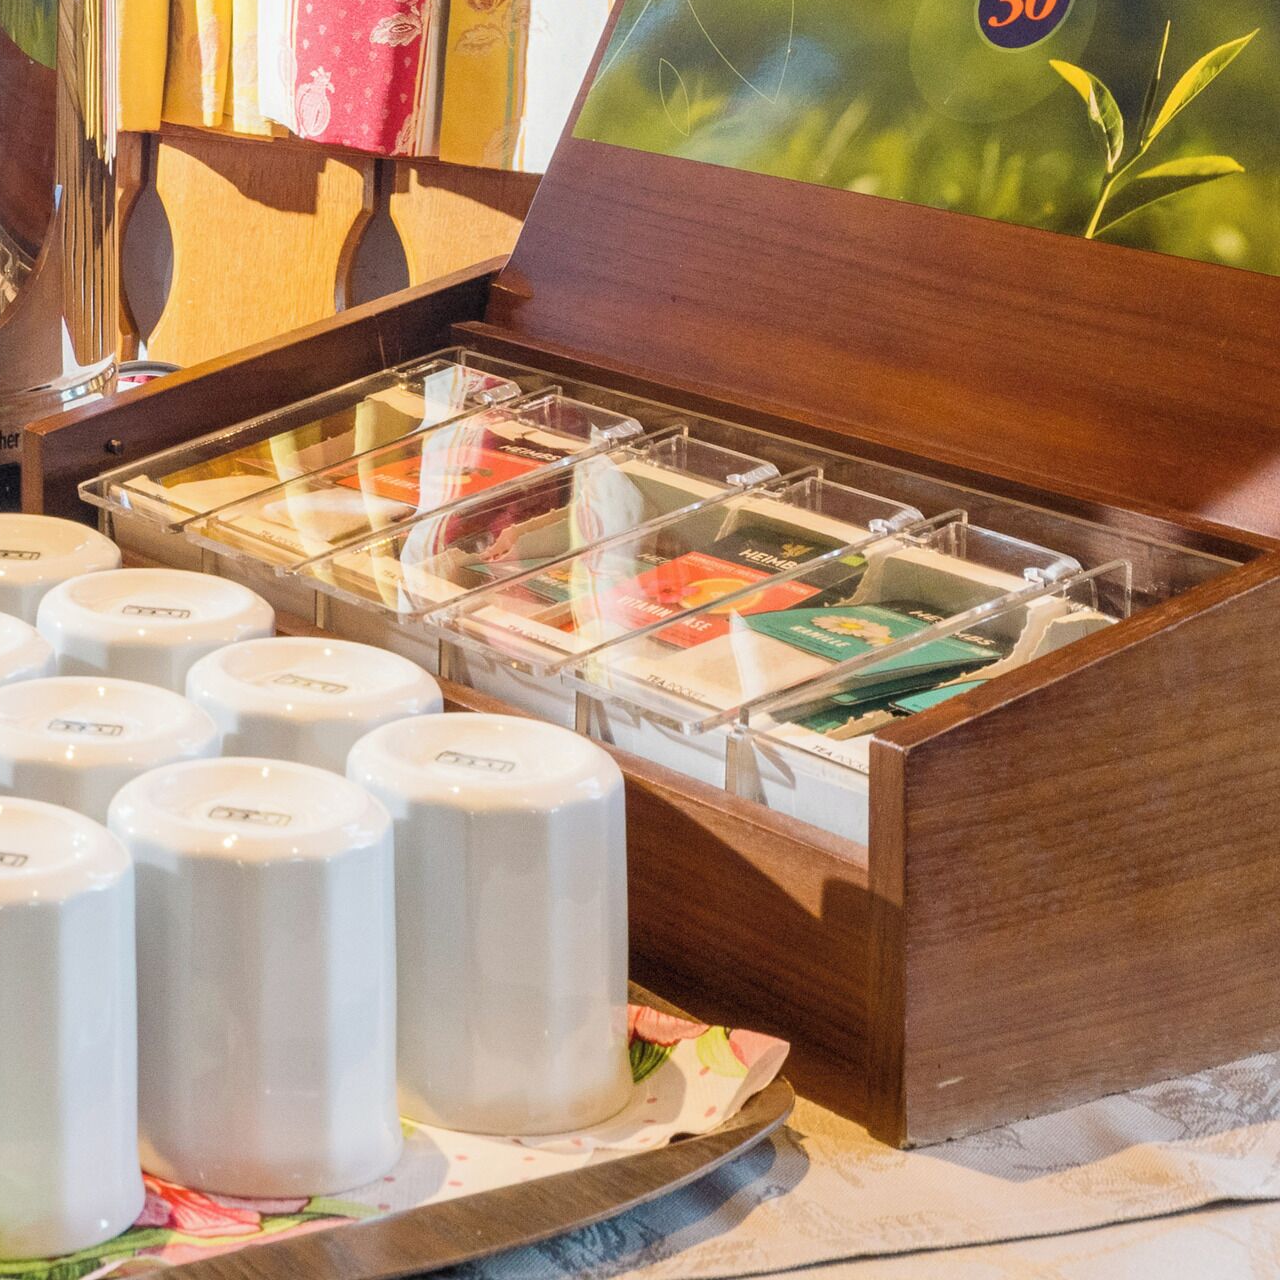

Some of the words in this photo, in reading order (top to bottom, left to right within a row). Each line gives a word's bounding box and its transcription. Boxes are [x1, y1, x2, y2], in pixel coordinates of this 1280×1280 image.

[499, 444, 562, 462] HEIMBS
[738, 548, 802, 570] HEIMB
[617, 595, 673, 618] VITAMIN
[790, 625, 852, 648] KAMILLE
[646, 673, 666, 687] TEA
[812, 743, 833, 757] TEA
